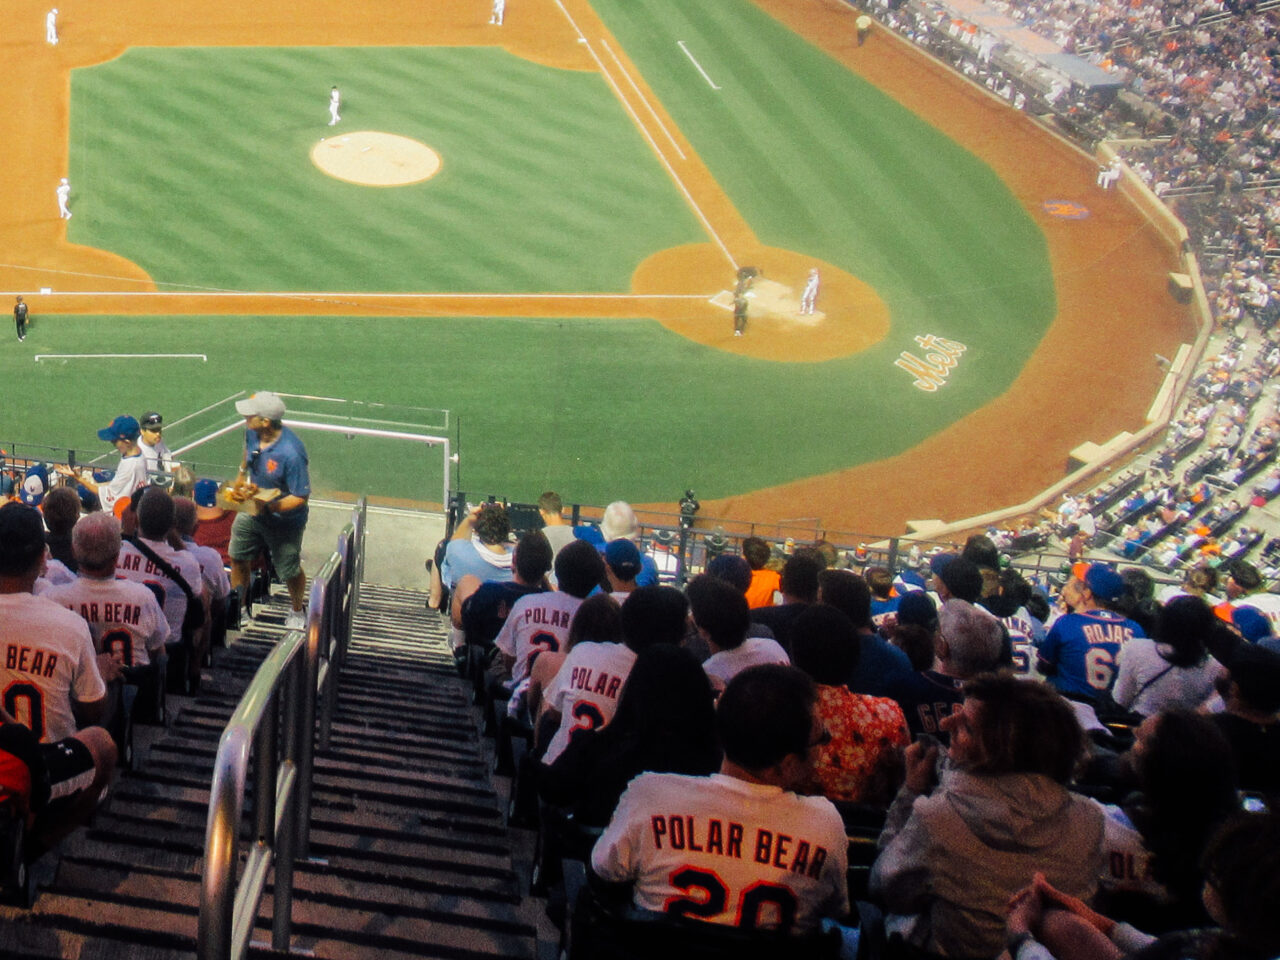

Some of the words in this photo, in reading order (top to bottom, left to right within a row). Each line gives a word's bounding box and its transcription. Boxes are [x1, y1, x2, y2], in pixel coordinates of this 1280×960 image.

[894, 334, 968, 392] Mets
[104, 602, 142, 626] BEAR
[524, 608, 570, 628] POLAR
[1083, 624, 1134, 645] ROJAS
[6, 644, 58, 678] BEAR
[1084, 647, 1121, 690] 6
[570, 666, 622, 699] POLAR
[651, 814, 745, 860] POLAR
[754, 828, 829, 881] BEAR
[664, 864, 798, 931] 20
